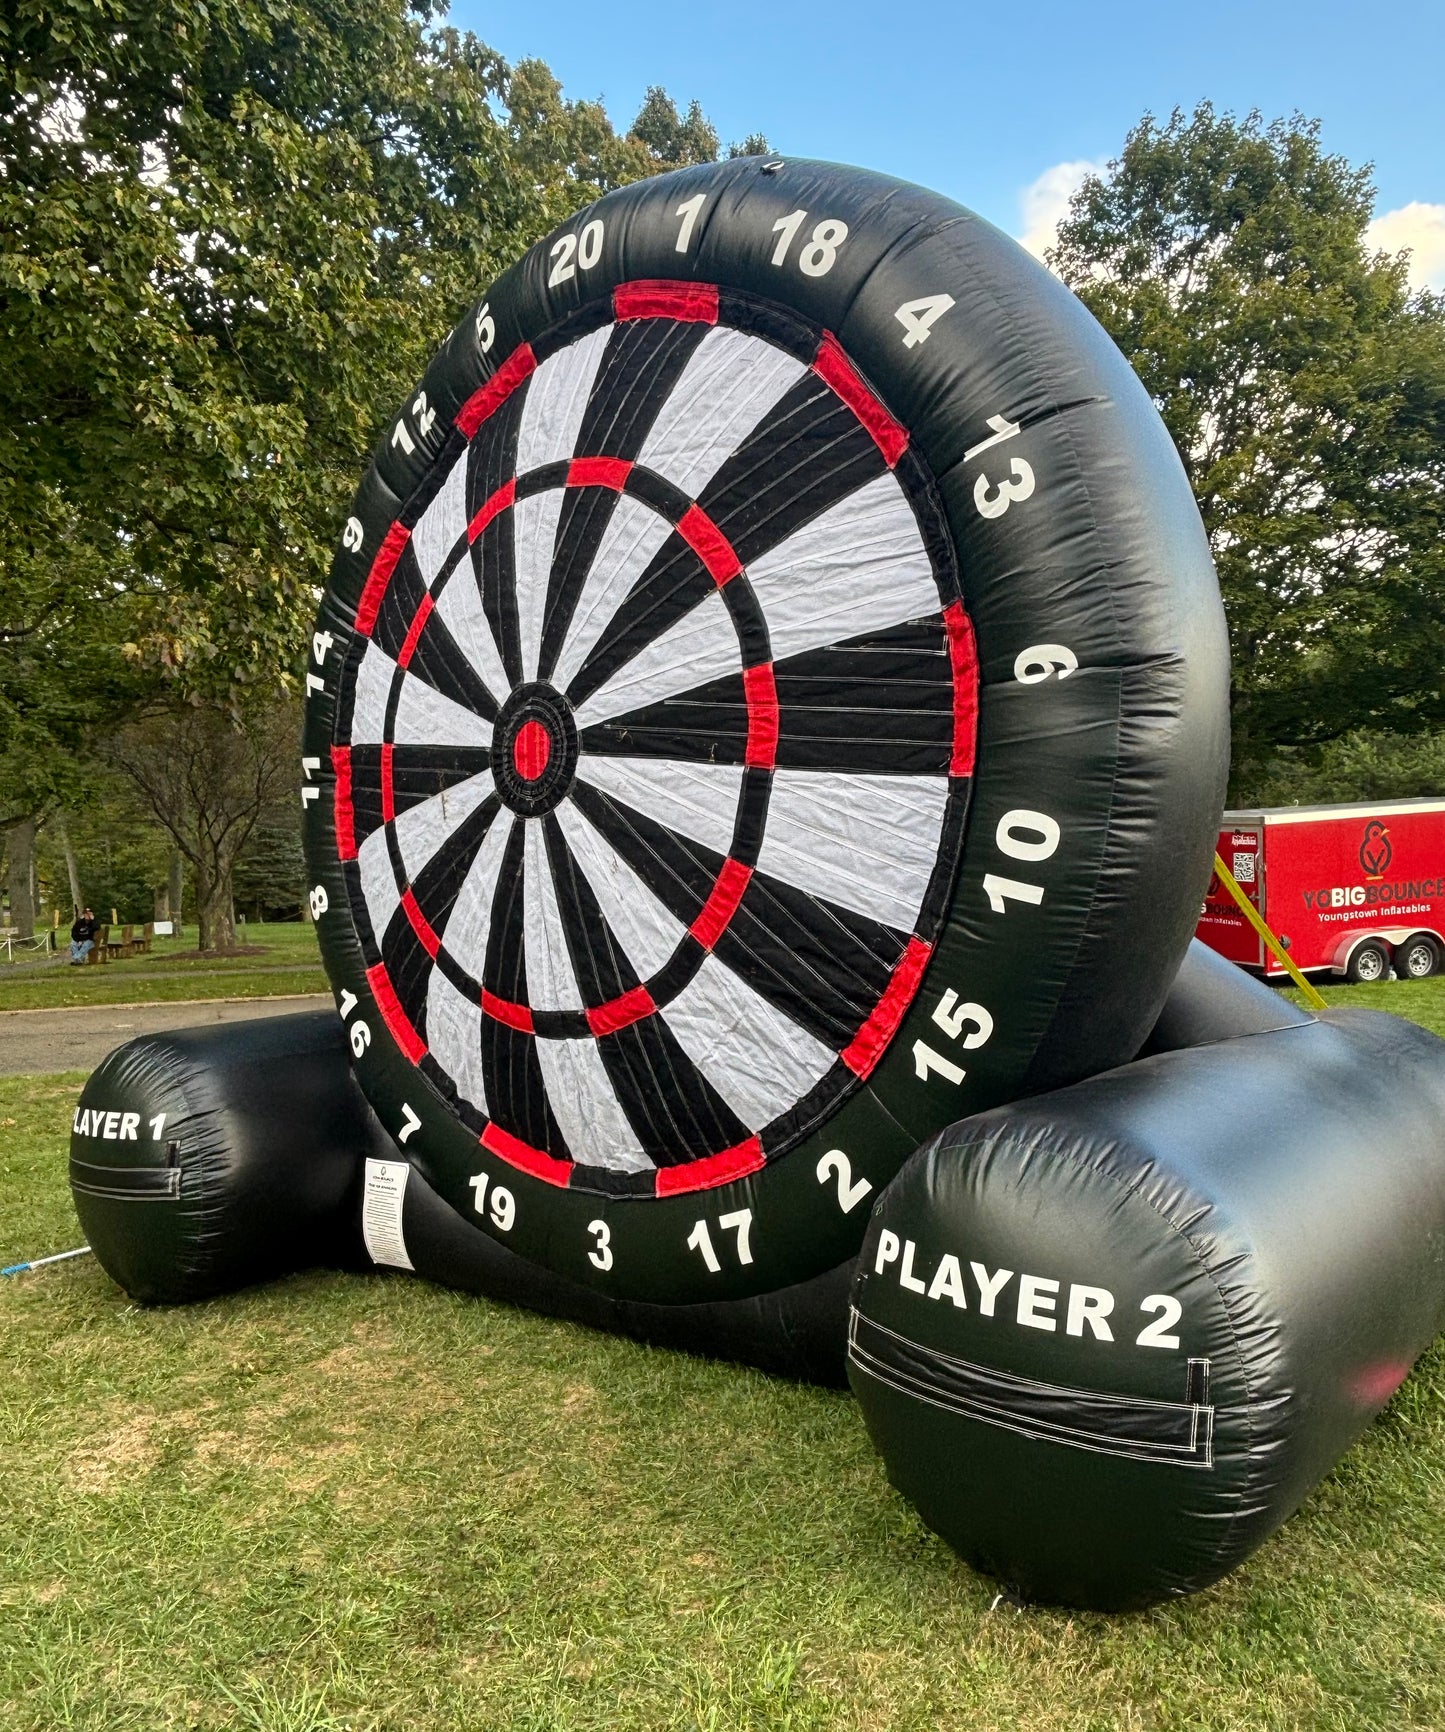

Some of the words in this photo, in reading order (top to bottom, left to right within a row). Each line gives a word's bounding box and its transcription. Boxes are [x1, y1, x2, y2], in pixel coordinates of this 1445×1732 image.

[547, 219, 605, 289] 20
[675, 194, 711, 254] 1
[770, 208, 849, 278] 18
[476, 303, 496, 354] 5
[894, 293, 956, 349] 4
[391, 389, 437, 456] 12
[963, 413, 1037, 519] 13
[306, 631, 334, 697] 14
[1014, 643, 1078, 686] 6
[301, 757, 321, 809] 11
[983, 809, 1061, 914] 10
[309, 884, 329, 921] 8
[1303, 878, 1445, 909] YOBIGBOUNCE
[1318, 909, 1377, 922] Youngstown
[1381, 904, 1431, 916] Inflatables
[339, 988, 372, 1059] 16
[912, 987, 994, 1086] 15
[73, 1106, 141, 1141] LAYER
[149, 1112, 167, 1141] 1
[398, 1102, 422, 1144] 7
[468, 1171, 516, 1232] 19
[816, 1149, 873, 1214] 2
[587, 1219, 614, 1272] 3
[686, 1207, 754, 1273] 17
[874, 1228, 1115, 1342] PLAYER
[1136, 1293, 1183, 1350] 2
